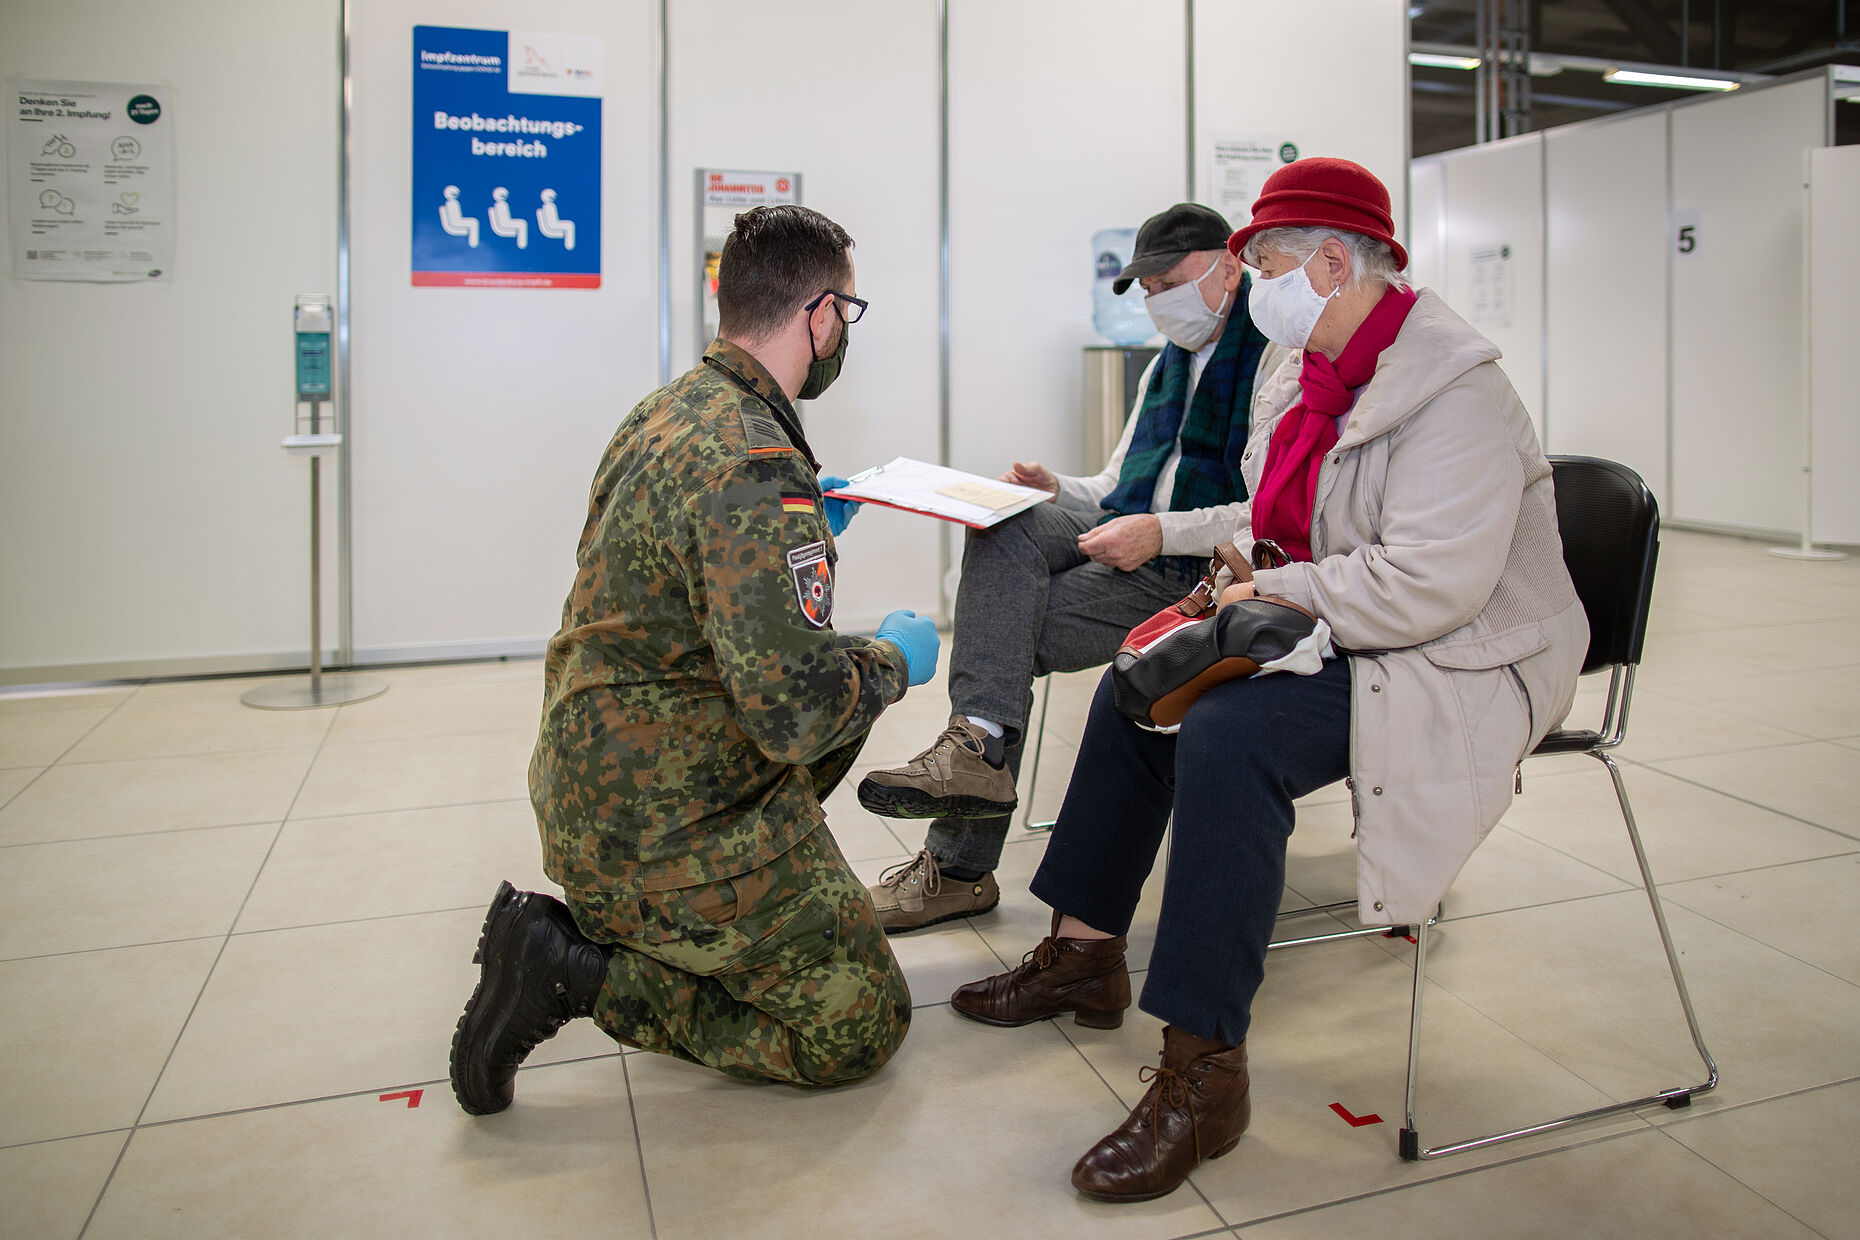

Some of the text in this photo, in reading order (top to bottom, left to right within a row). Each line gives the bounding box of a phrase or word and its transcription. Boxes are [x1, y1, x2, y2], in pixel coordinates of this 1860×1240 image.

[420, 50, 501, 66] Impfzentrum
[18, 96, 77, 107] Denken Sie
[19, 107, 111, 120] an Ihre 2. Impfung!
[433, 110, 584, 139] Beobachtungs-
[471, 136, 548, 158] bereich
[1678, 225, 1696, 254] 5
